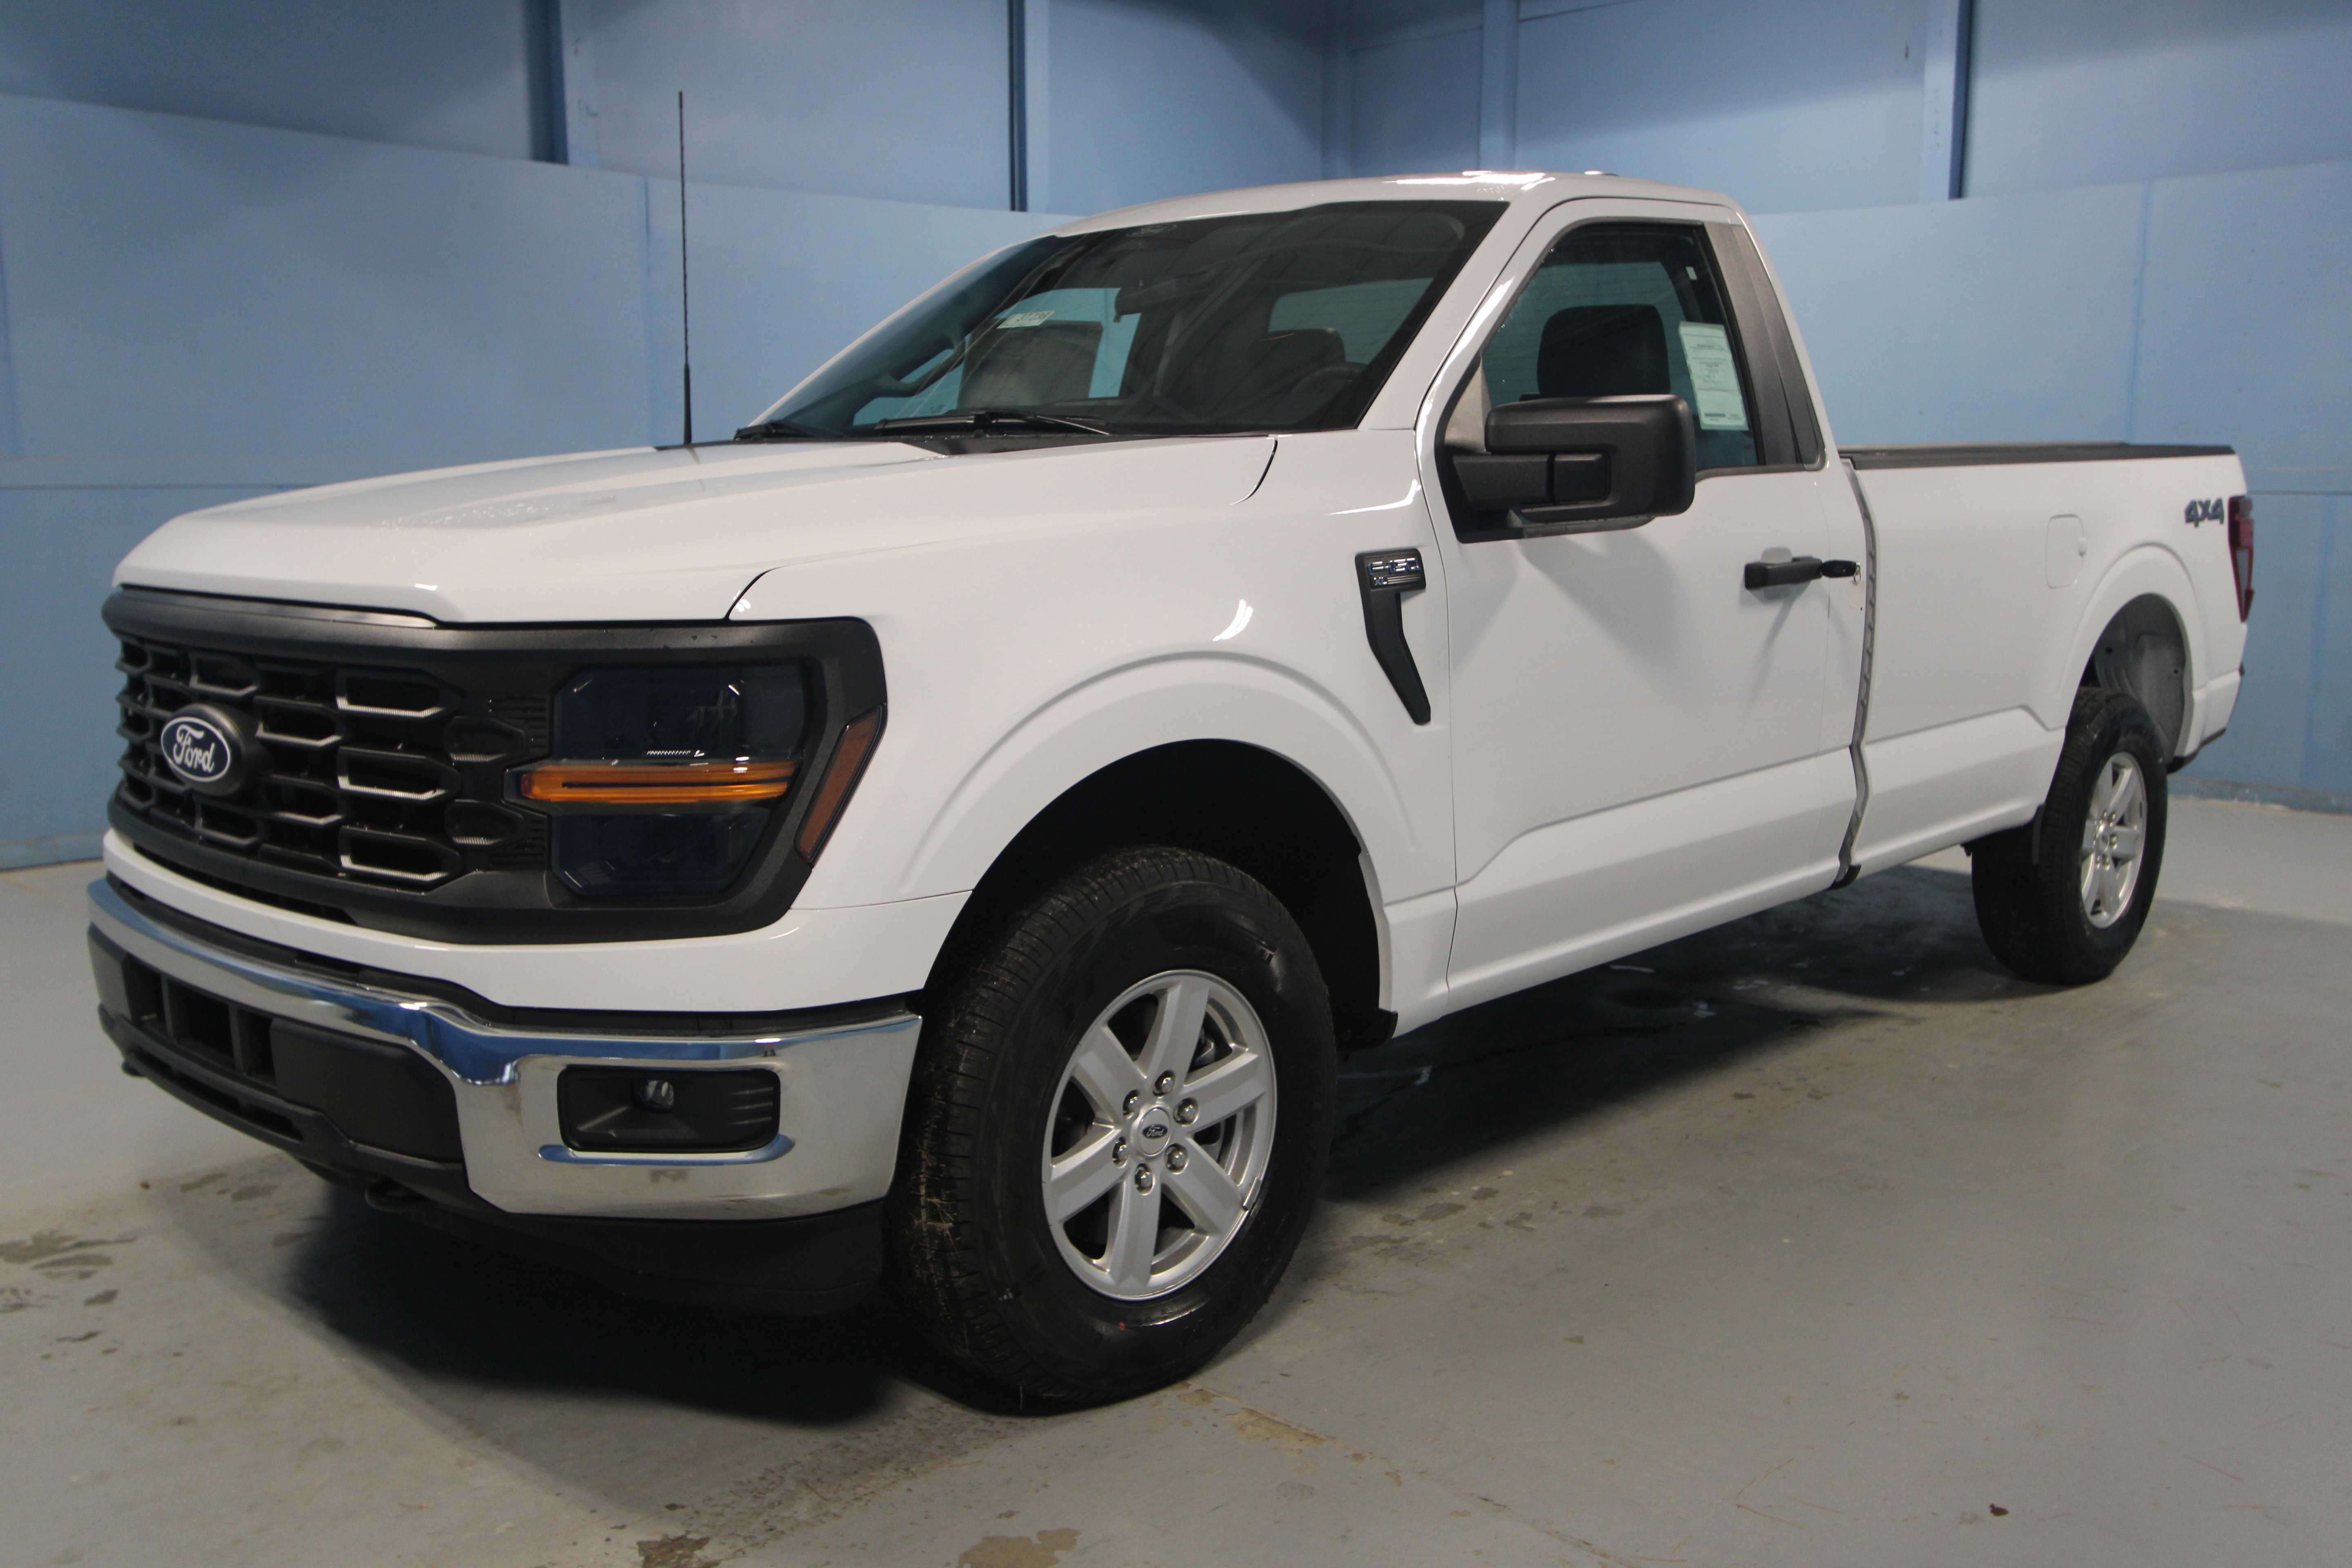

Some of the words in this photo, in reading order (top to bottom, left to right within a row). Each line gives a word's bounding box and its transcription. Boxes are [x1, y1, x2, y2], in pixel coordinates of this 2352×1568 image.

[1367, 557, 1421, 575] F-150
[173, 724, 215, 773] Ford
[1146, 1125, 1164, 1136] Ford
